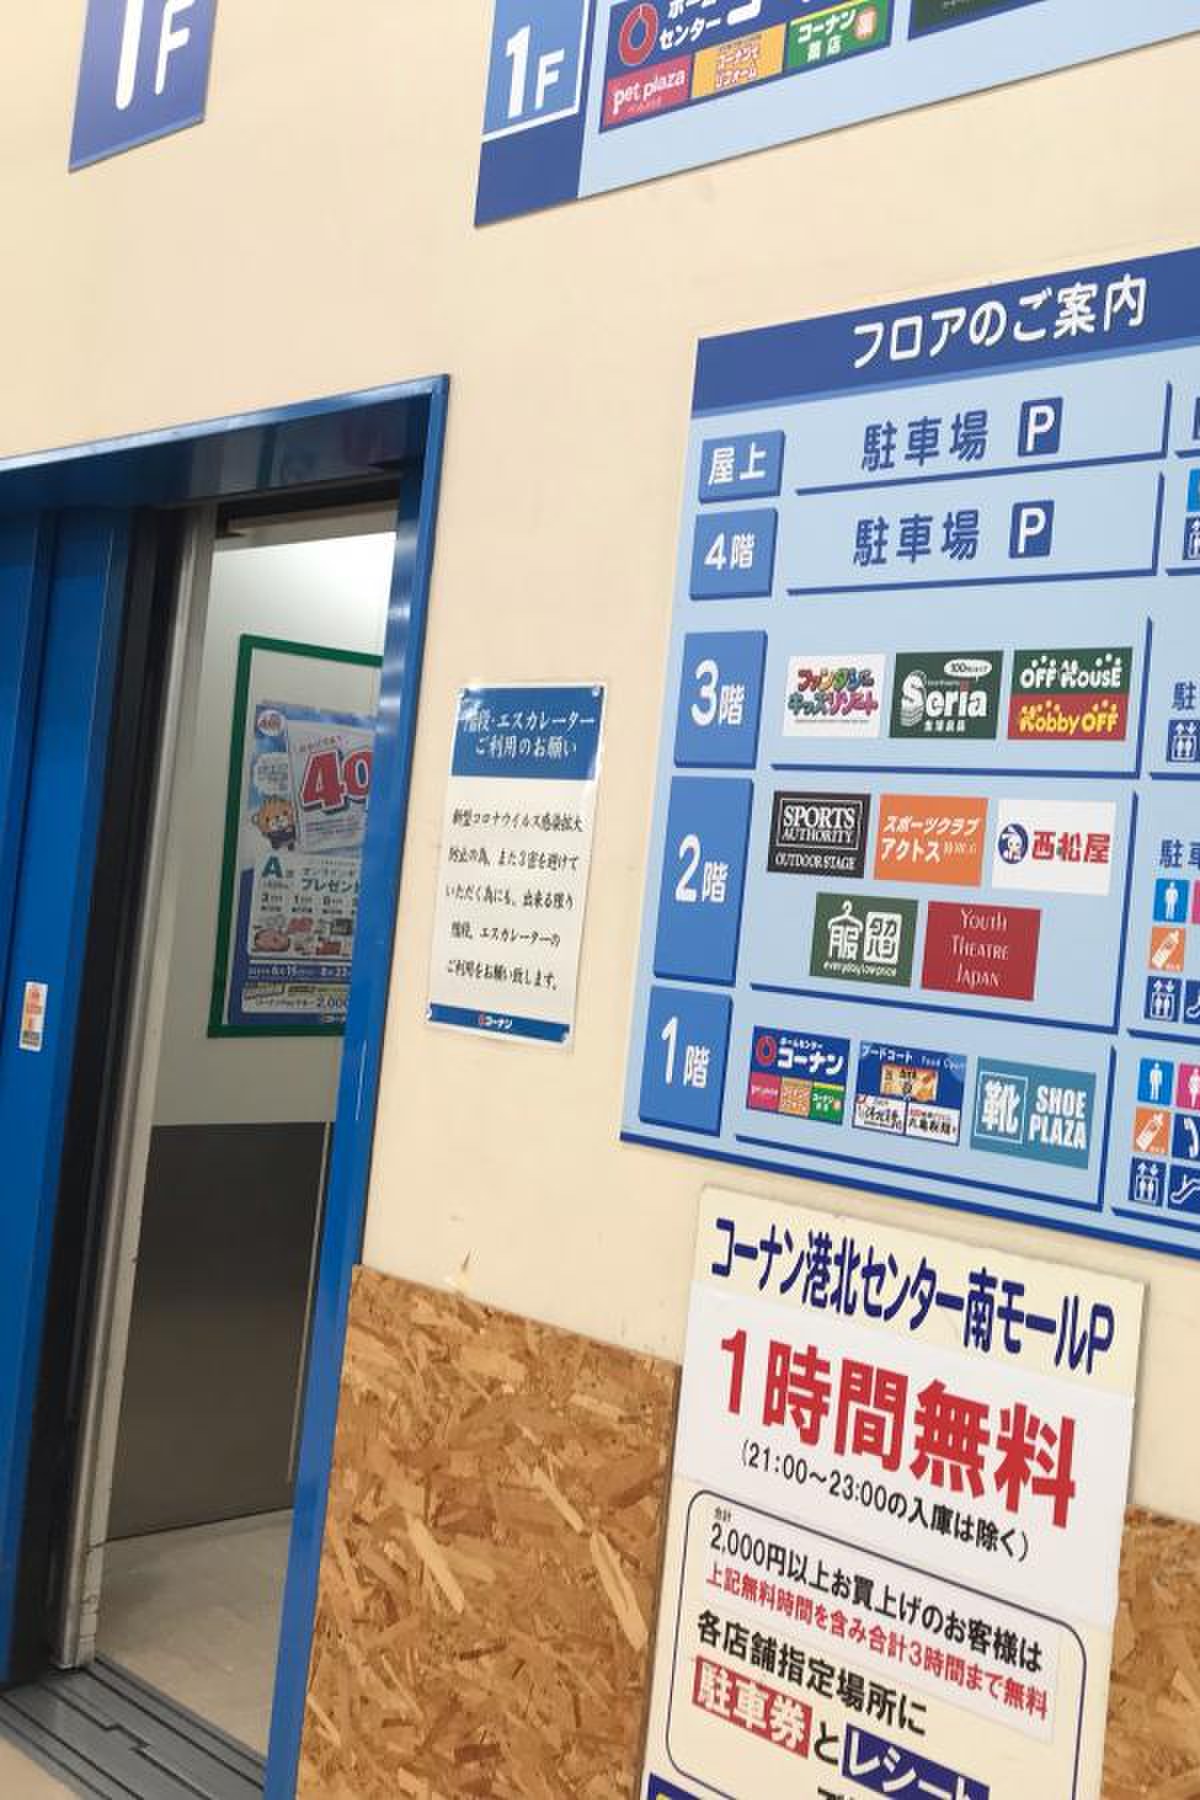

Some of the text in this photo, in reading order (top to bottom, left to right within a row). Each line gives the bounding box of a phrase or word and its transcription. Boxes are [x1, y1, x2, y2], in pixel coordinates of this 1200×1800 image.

[506, 24, 565, 118] 1F
[612, 83, 640, 114] pet
[643, 68, 686, 100] plaza
[852, 274, 1148, 369] フロアのご案内
[861, 410, 989, 471] 駐車場
[708, 443, 767, 487] 屋上
[704, 531, 755, 570] 4階
[853, 511, 980, 568] 駐車場
[690, 659, 746, 727] 3階
[1020, 658, 1122, 689] OFF HOUSE
[901, 670, 988, 726] Seria
[1081, 709, 1119, 734] OFF
[475, 735, 577, 759] ご利用のお願い
[781, 829, 854, 844] AUTHORITY
[784, 804, 856, 829] SPORTS
[884, 815, 980, 836] スポーツクラブ
[675, 832, 729, 904] 2階
[880, 837, 941, 864] アクトス
[1031, 831, 1111, 864] 西松屋
[660, 1015, 711, 1089] 1階
[777, 1047, 844, 1075] コーナン
[981, 1080, 1020, 1135] 靴
[1036, 1084, 1087, 1118] SHOE
[1028, 1117, 1087, 1150] PLAZA
[710, 1216, 1115, 1376] コーナン港北センター南モールP
[720, 1328, 1077, 1530] 1時間無料
[697, 1609, 928, 1736] 各店舗指定場所に
